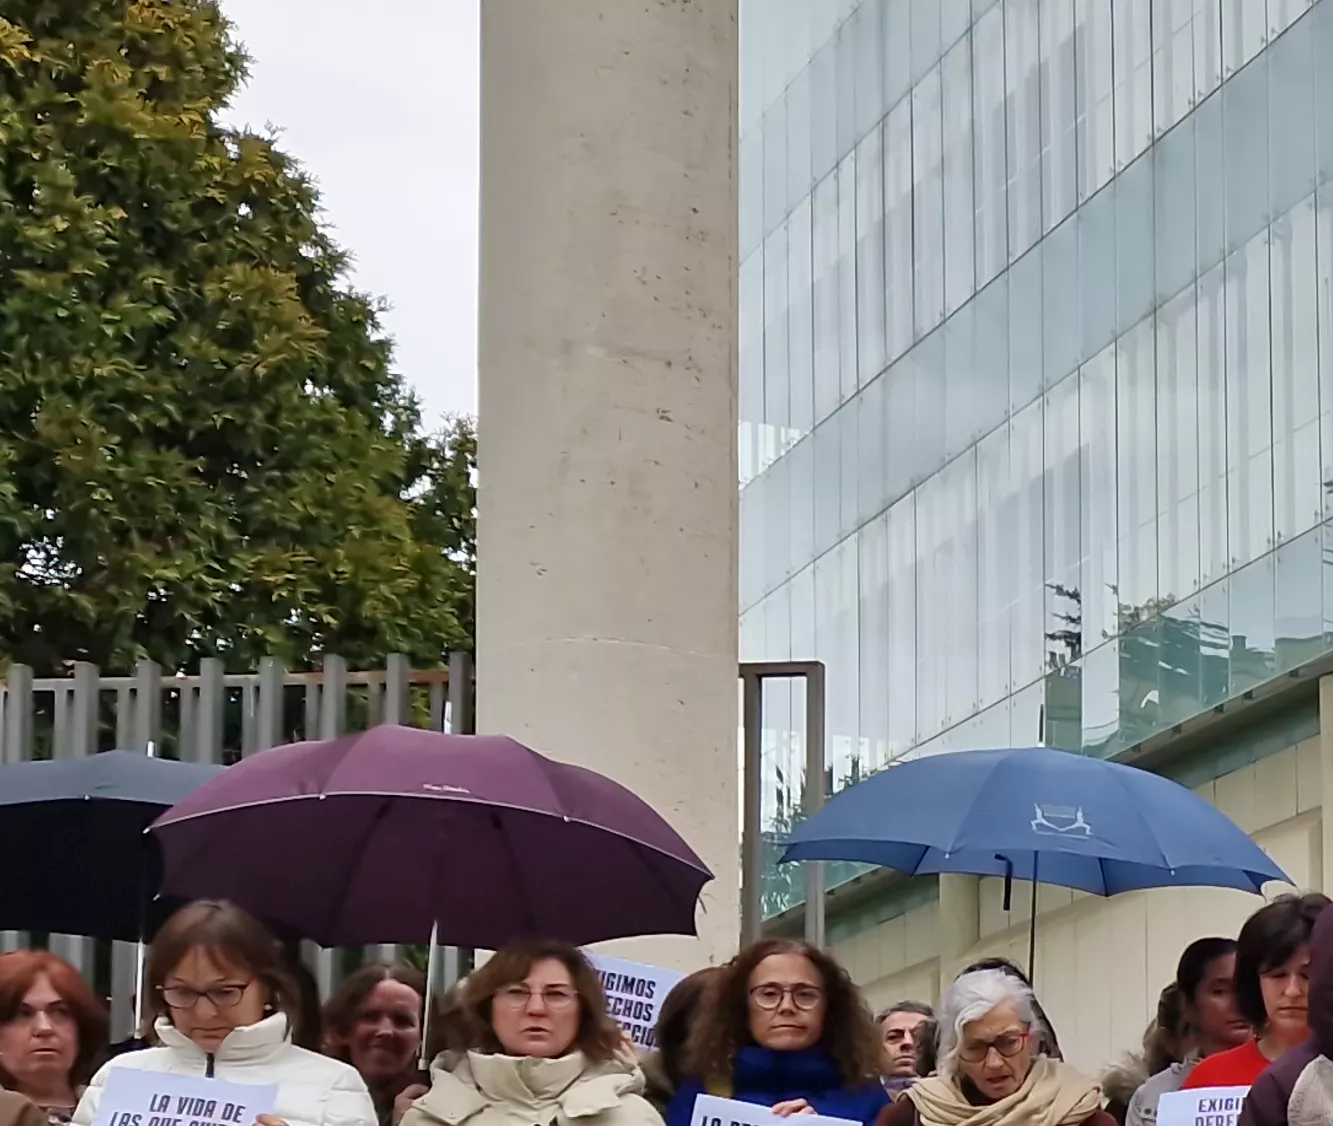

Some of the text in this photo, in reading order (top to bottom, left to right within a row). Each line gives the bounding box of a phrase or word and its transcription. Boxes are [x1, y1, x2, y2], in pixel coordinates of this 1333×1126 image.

[149, 1093, 247, 1124] LA VIDA DE
